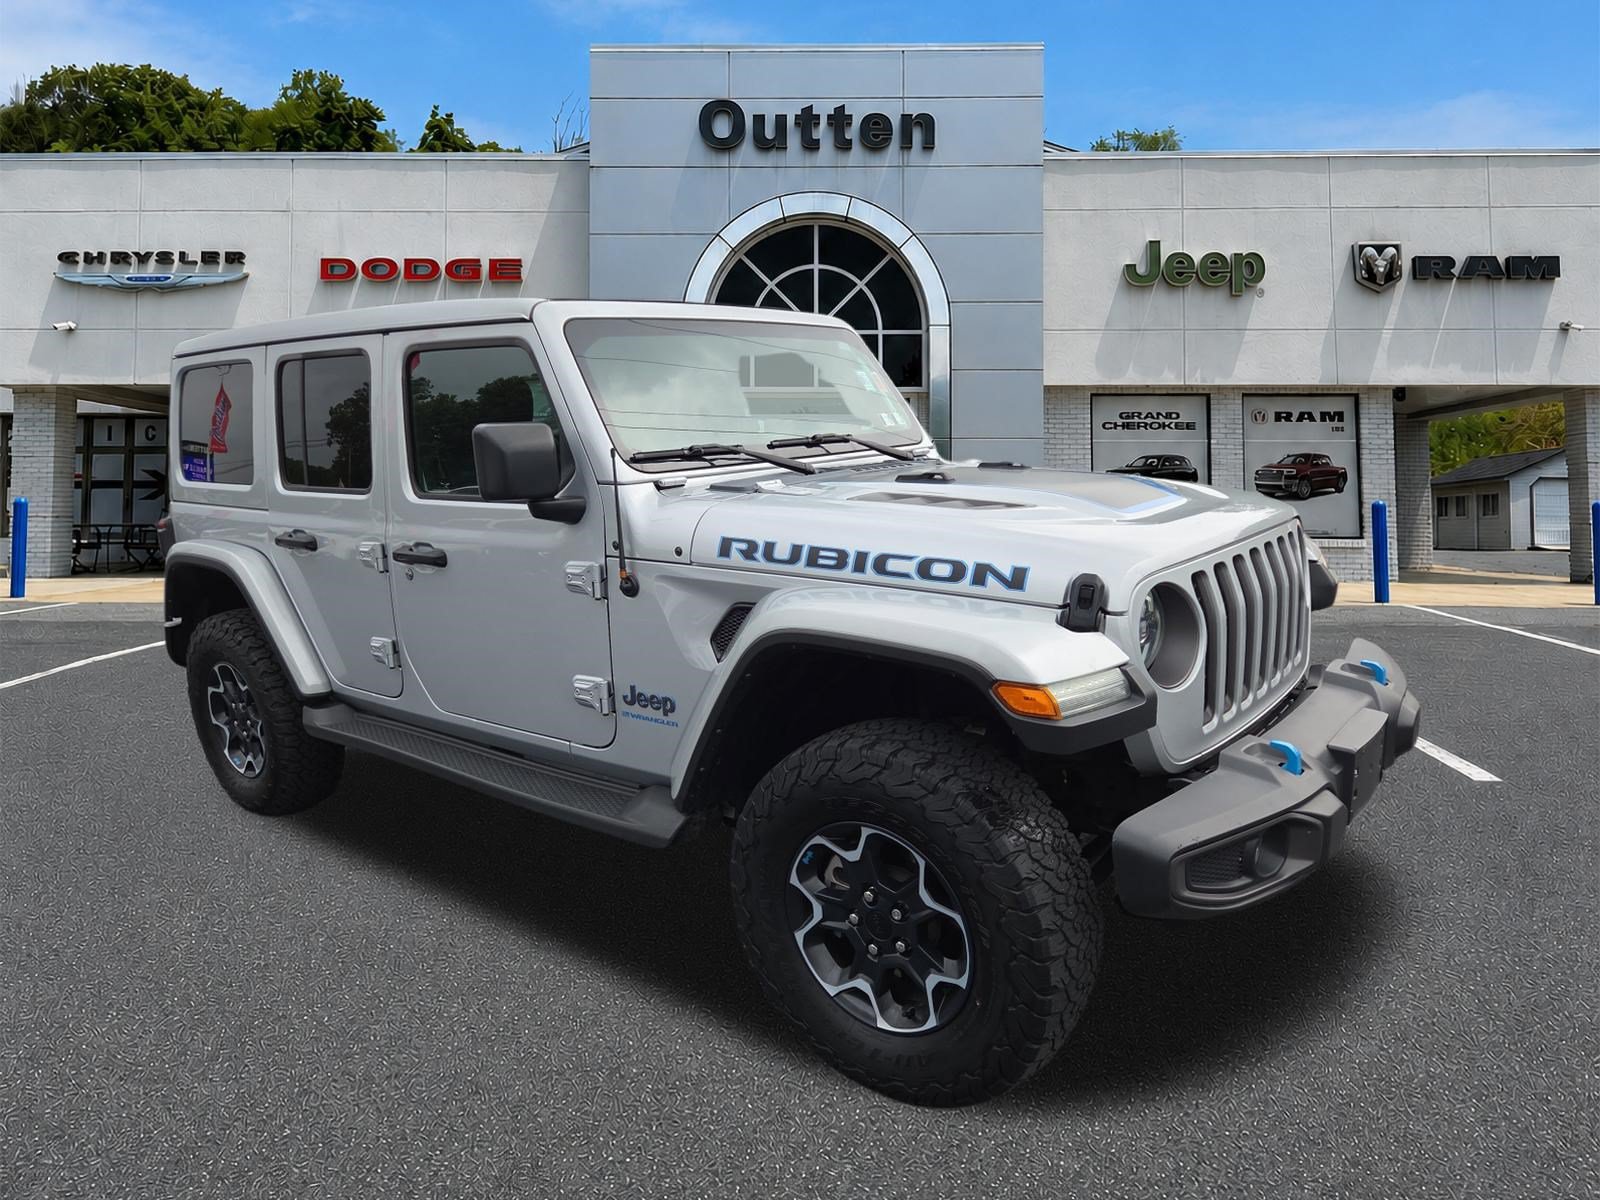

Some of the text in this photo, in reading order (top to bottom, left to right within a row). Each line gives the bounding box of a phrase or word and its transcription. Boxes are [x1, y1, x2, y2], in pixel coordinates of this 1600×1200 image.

[699, 99, 936, 151] Outten
[57, 250, 247, 266] CHRYSLER
[320, 257, 523, 283] DODGE
[1124, 240, 1266, 297] Jeep
[1412, 255, 1561, 280] RAM
[1101, 421, 1197, 431] CHEROKEE
[1118, 411, 1181, 421] GRAND
[1274, 410, 1345, 423] RAM
[716, 535, 1031, 593] RUBICON
[622, 684, 677, 717] Jeep
